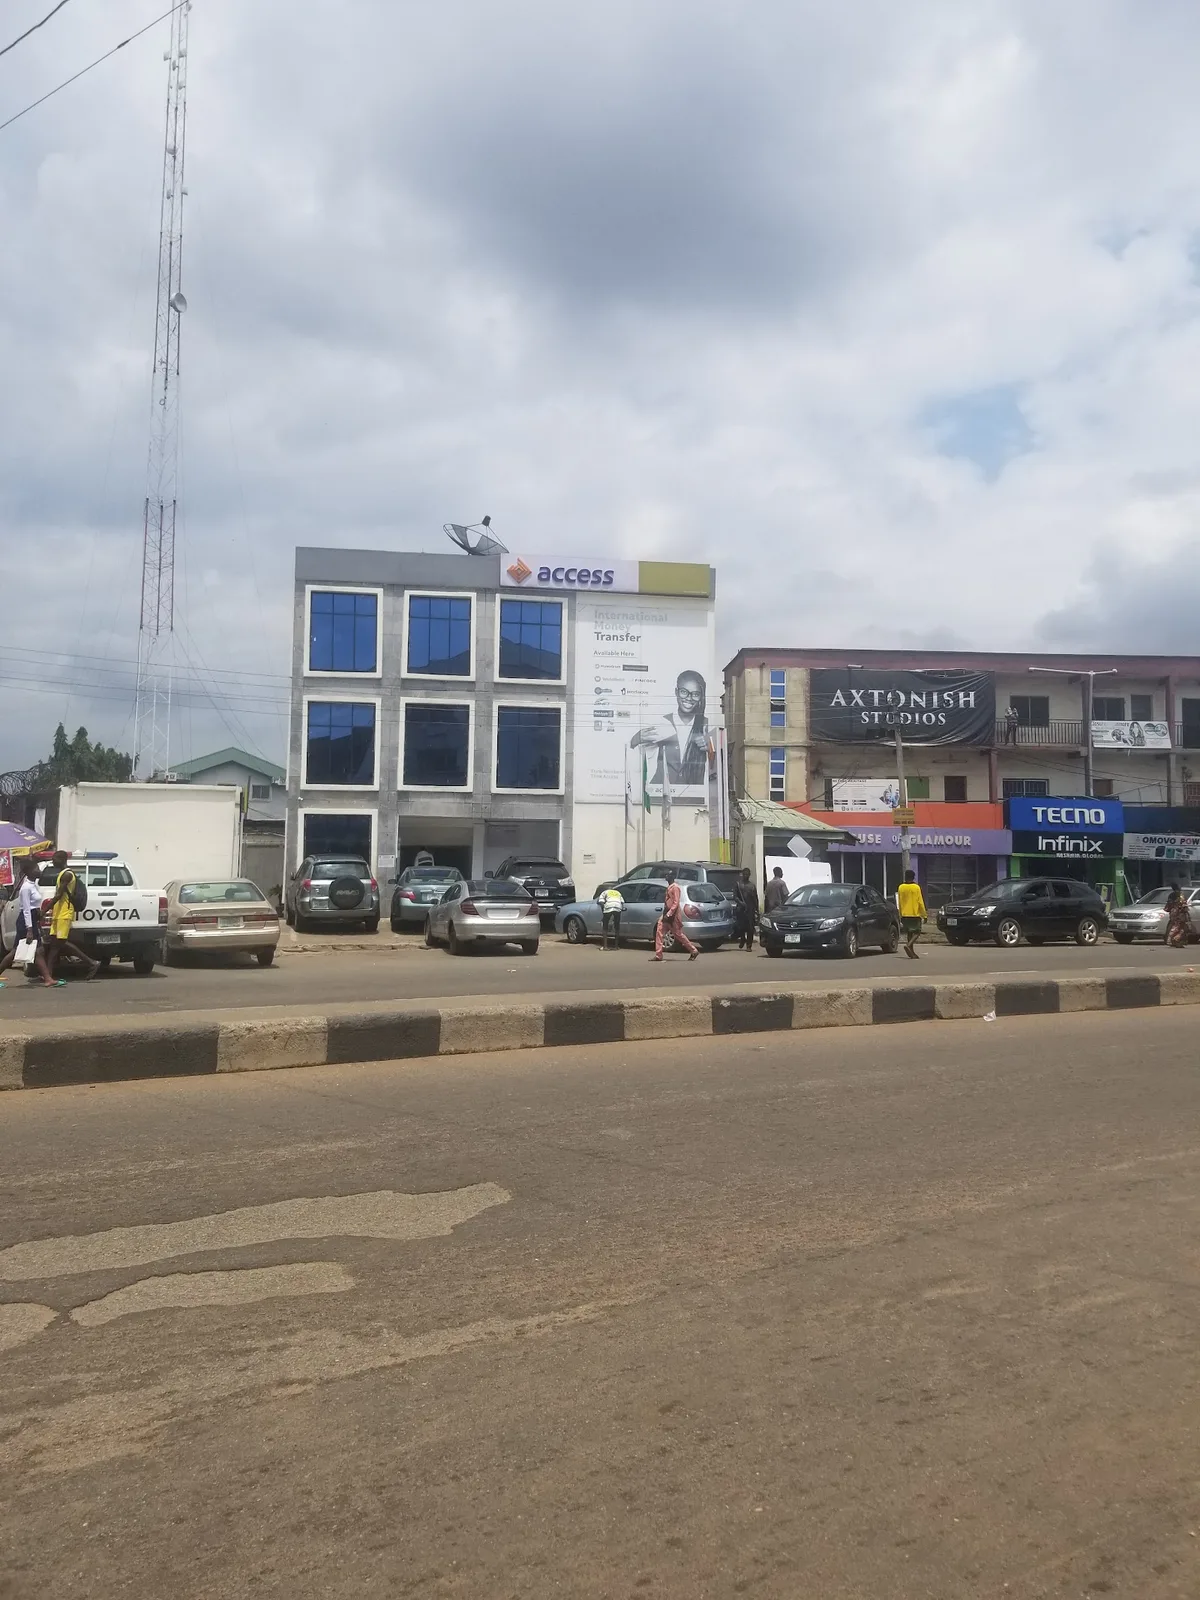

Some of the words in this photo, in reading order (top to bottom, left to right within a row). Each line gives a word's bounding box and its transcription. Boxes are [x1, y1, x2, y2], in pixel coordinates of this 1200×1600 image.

[537, 566, 615, 586] access
[594, 609, 668, 622] International
[594, 620, 631, 632] Money
[594, 631, 642, 642] Transfer
[830, 688, 977, 709] AXTONISH
[860, 711, 947, 725] STUDIOS
[1032, 806, 1106, 825] TECNO
[909, 833, 972, 846] GLAMOUR
[1038, 836, 1103, 853] Infinix
[1142, 836, 1176, 845] OMOVO
